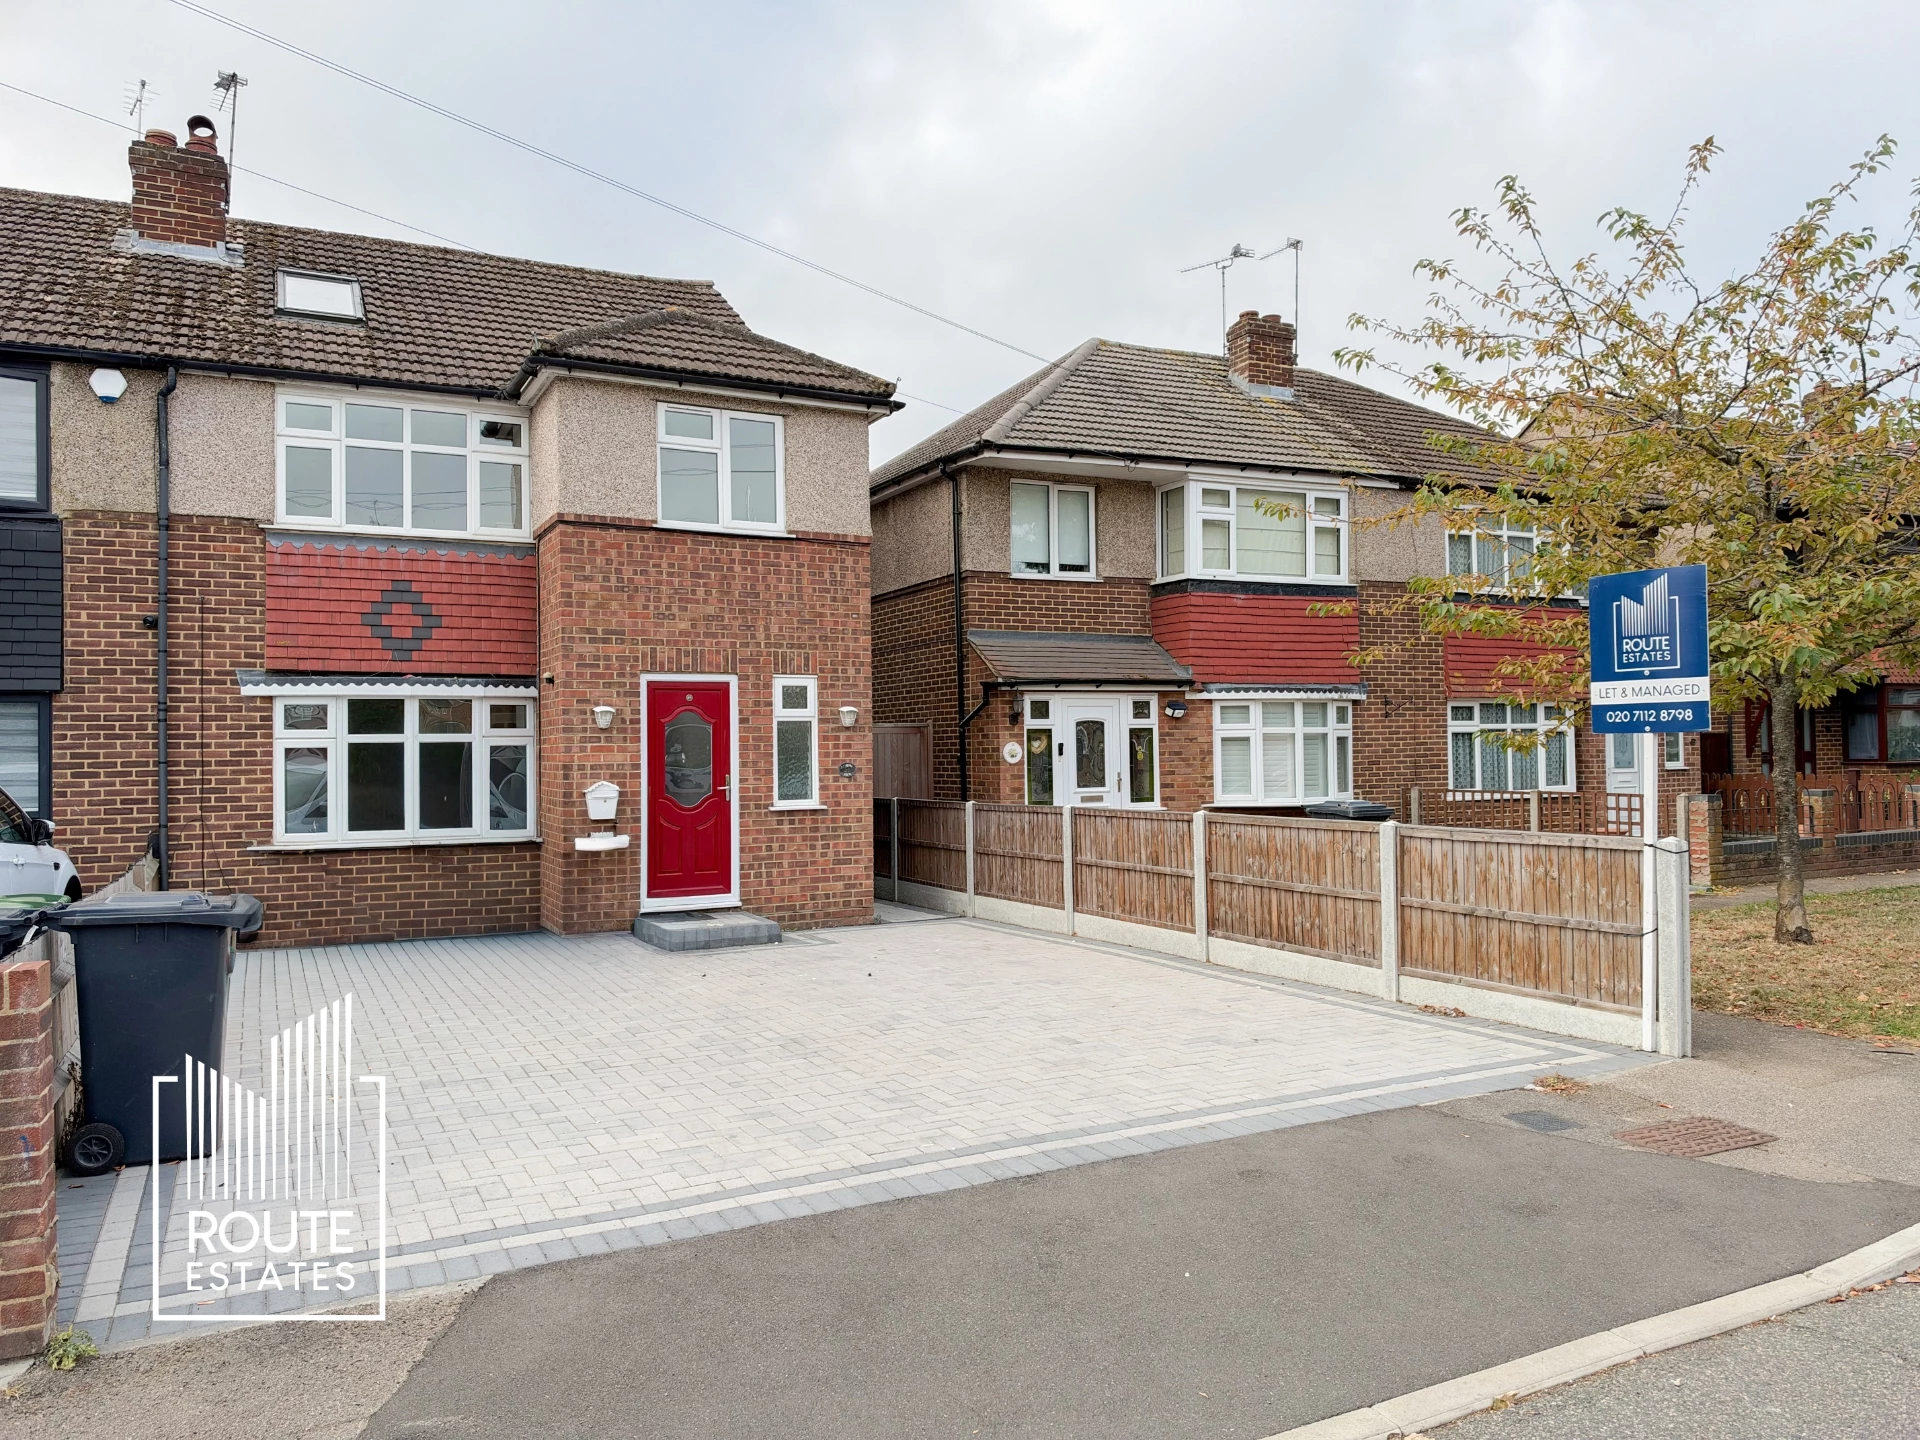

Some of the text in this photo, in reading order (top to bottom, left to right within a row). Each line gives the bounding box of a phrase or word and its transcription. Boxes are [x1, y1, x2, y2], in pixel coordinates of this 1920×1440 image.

[1623, 636, 1670, 652] ROUTE
[1622, 651, 1671, 663] ESTATES
[1599, 683, 1701, 699] LET & MANAGED
[1606, 709, 1693, 723] 020 7112 8798
